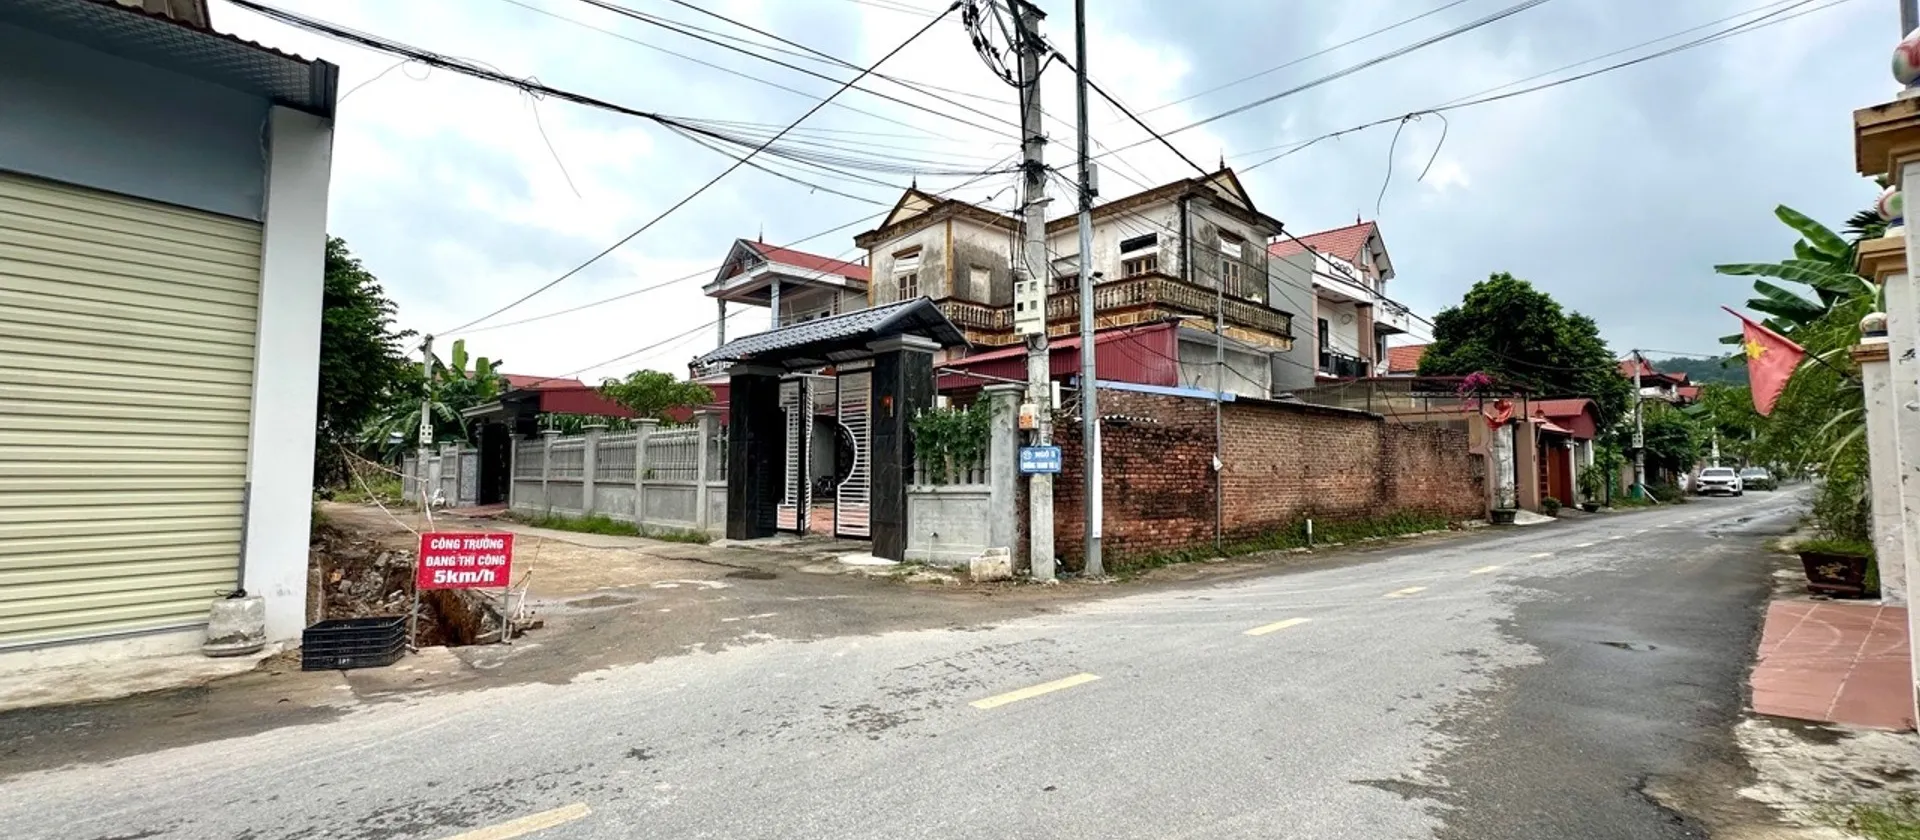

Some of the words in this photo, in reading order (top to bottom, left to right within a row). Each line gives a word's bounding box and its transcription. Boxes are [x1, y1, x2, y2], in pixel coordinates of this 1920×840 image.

[430, 537, 460, 549] CÔNG
[459, 556, 475, 566] THI
[477, 553, 506, 566] CÔNG
[433, 569, 495, 584] 5km/h
